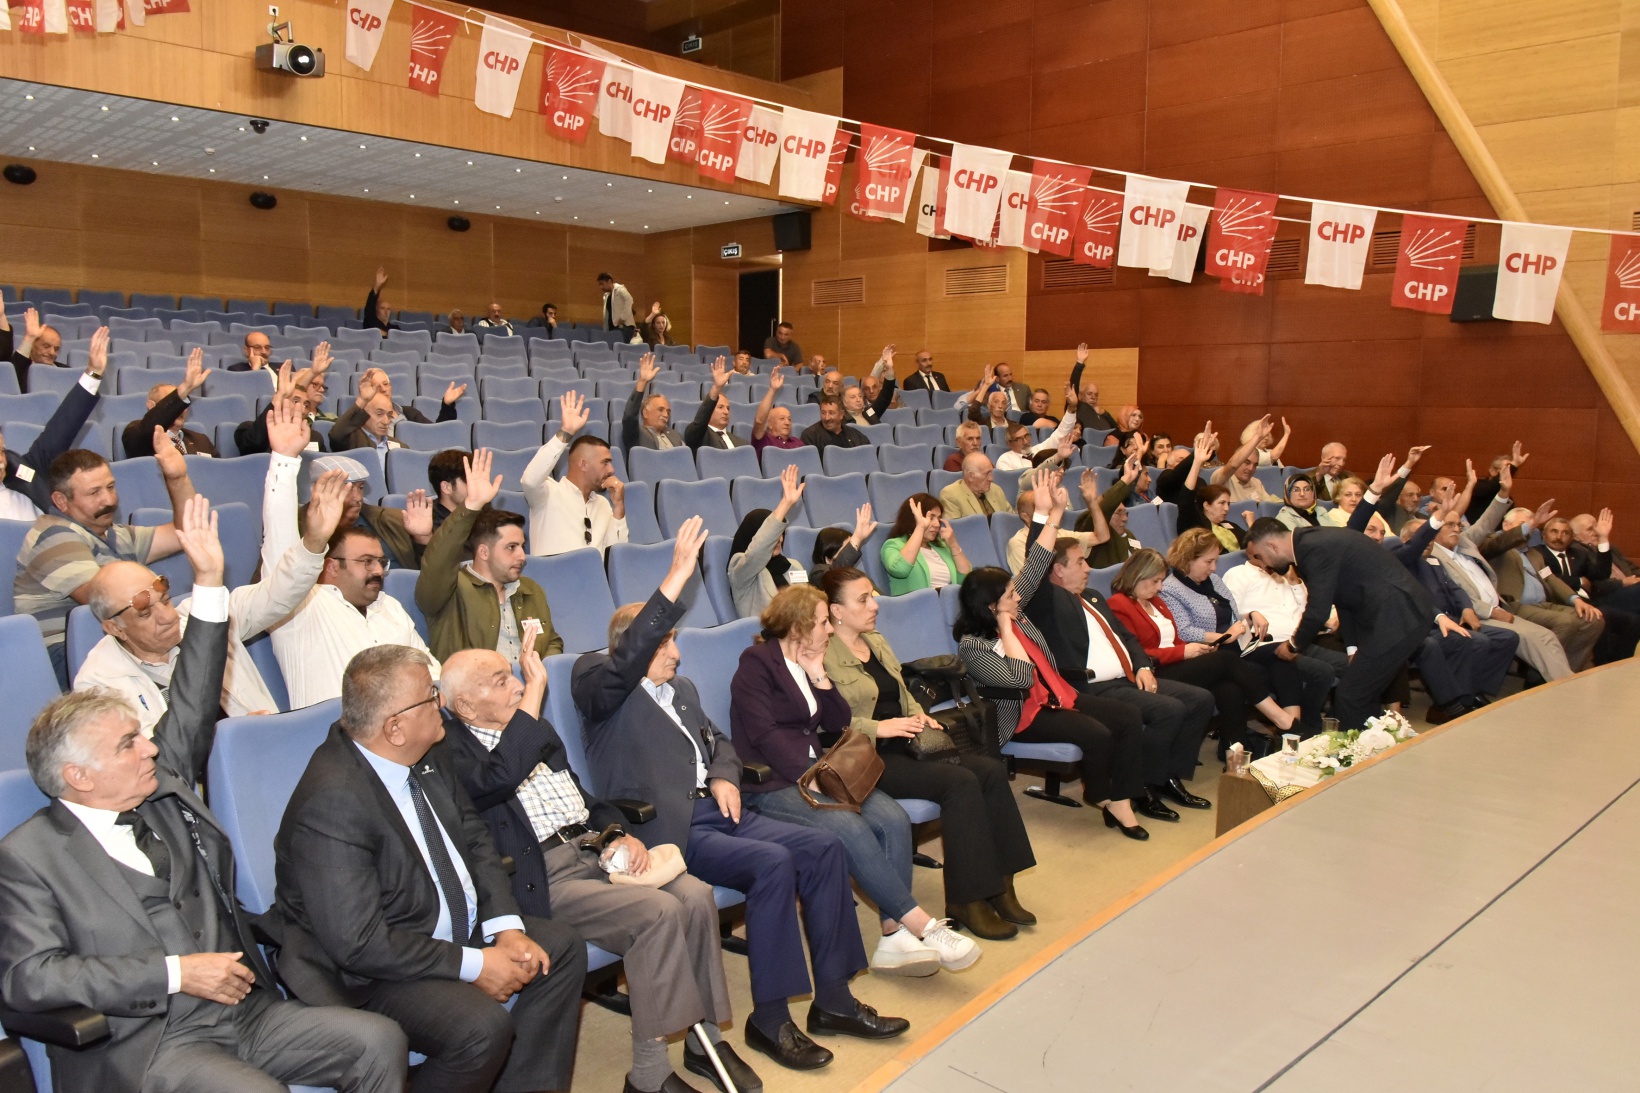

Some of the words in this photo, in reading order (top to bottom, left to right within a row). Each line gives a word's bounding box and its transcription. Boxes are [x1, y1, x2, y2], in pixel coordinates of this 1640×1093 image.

[68, 6, 92, 26] CH
[350, 8, 381, 32] CHP
[483, 51, 519, 75] CHP
[553, 111, 584, 131] CHP
[632, 98, 671, 123] CHP
[743, 126, 777, 148] CHP
[784, 135, 826, 160] CHP
[699, 149, 733, 172] CHP
[865, 183, 900, 203] CHP
[954, 169, 998, 194] CHP
[1129, 205, 1176, 228] CHP
[1031, 222, 1069, 245] CHP
[1317, 221, 1365, 244] CHP
[1084, 241, 1113, 261] CHP
[1215, 248, 1255, 269] CHP
[1505, 252, 1557, 276] CHP
[1404, 281, 1448, 302] CHP
[1614, 302, 1640, 320] CH
